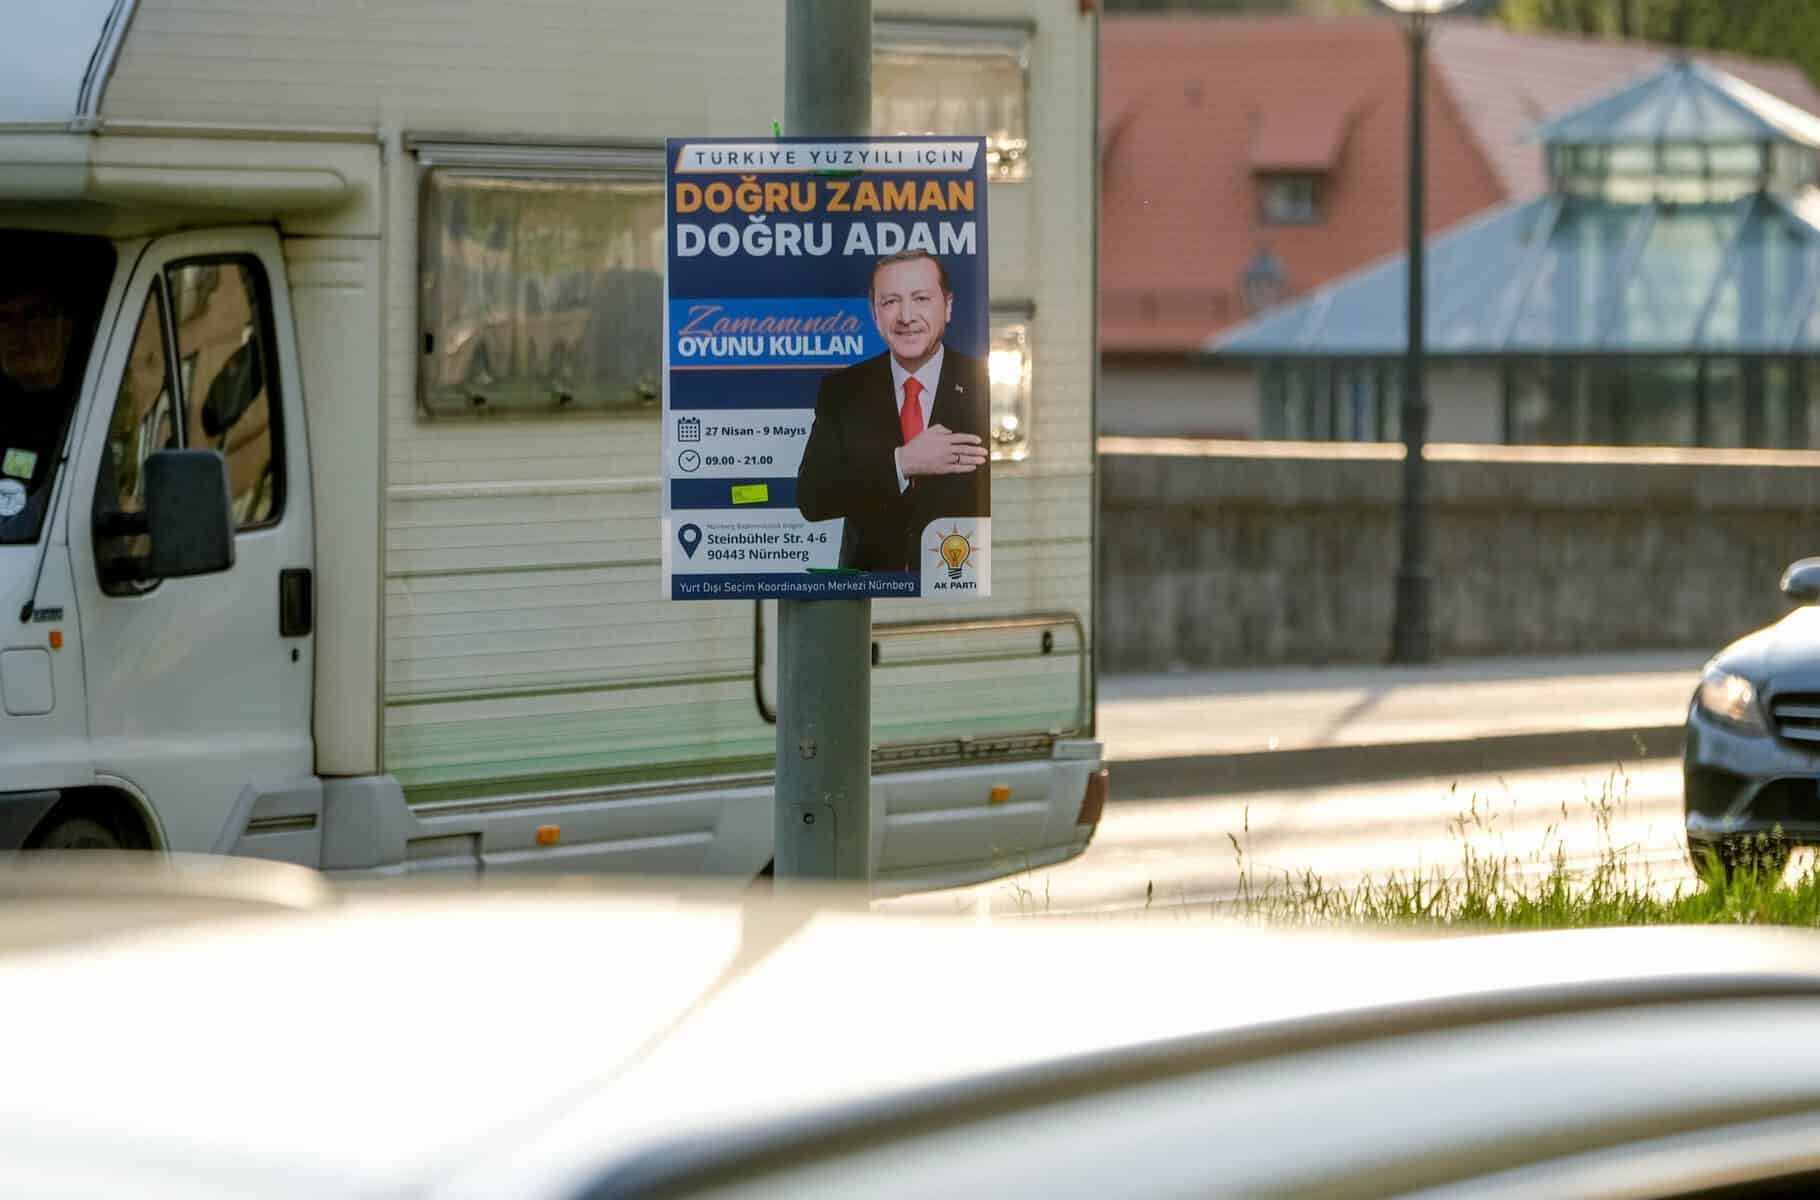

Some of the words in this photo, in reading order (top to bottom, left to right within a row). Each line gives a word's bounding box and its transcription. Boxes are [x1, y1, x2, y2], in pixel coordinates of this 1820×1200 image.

[675, 175, 817, 212] DOĞRU
[826, 180, 975, 212] ZAMAN
[676, 215, 833, 257] DOĞRU
[842, 221, 977, 256] ADAM
[678, 335, 764, 357] OYUNU
[769, 335, 864, 356] KULLAN
[705, 427, 718, 436] 27
[721, 426, 754, 436] Nisan
[763, 427, 769, 435] 9
[773, 426, 806, 438] Mayıs
[705, 456, 734, 465] 09.00
[744, 456, 773, 465] 21.00
[707, 533, 780, 545] Steinbühler
[783, 533, 803, 544] Str.
[807, 533, 827, 543] 4-6
[707, 550, 745, 560] 90443
[749, 549, 809, 561] Nürnberg
[680, 583, 700, 593] Yurt
[758, 582, 825, 593] Koordinasyon
[828, 581, 866, 591] Merkezi
[869, 579, 914, 592] Nürnberg
[934, 582, 947, 590] AK
